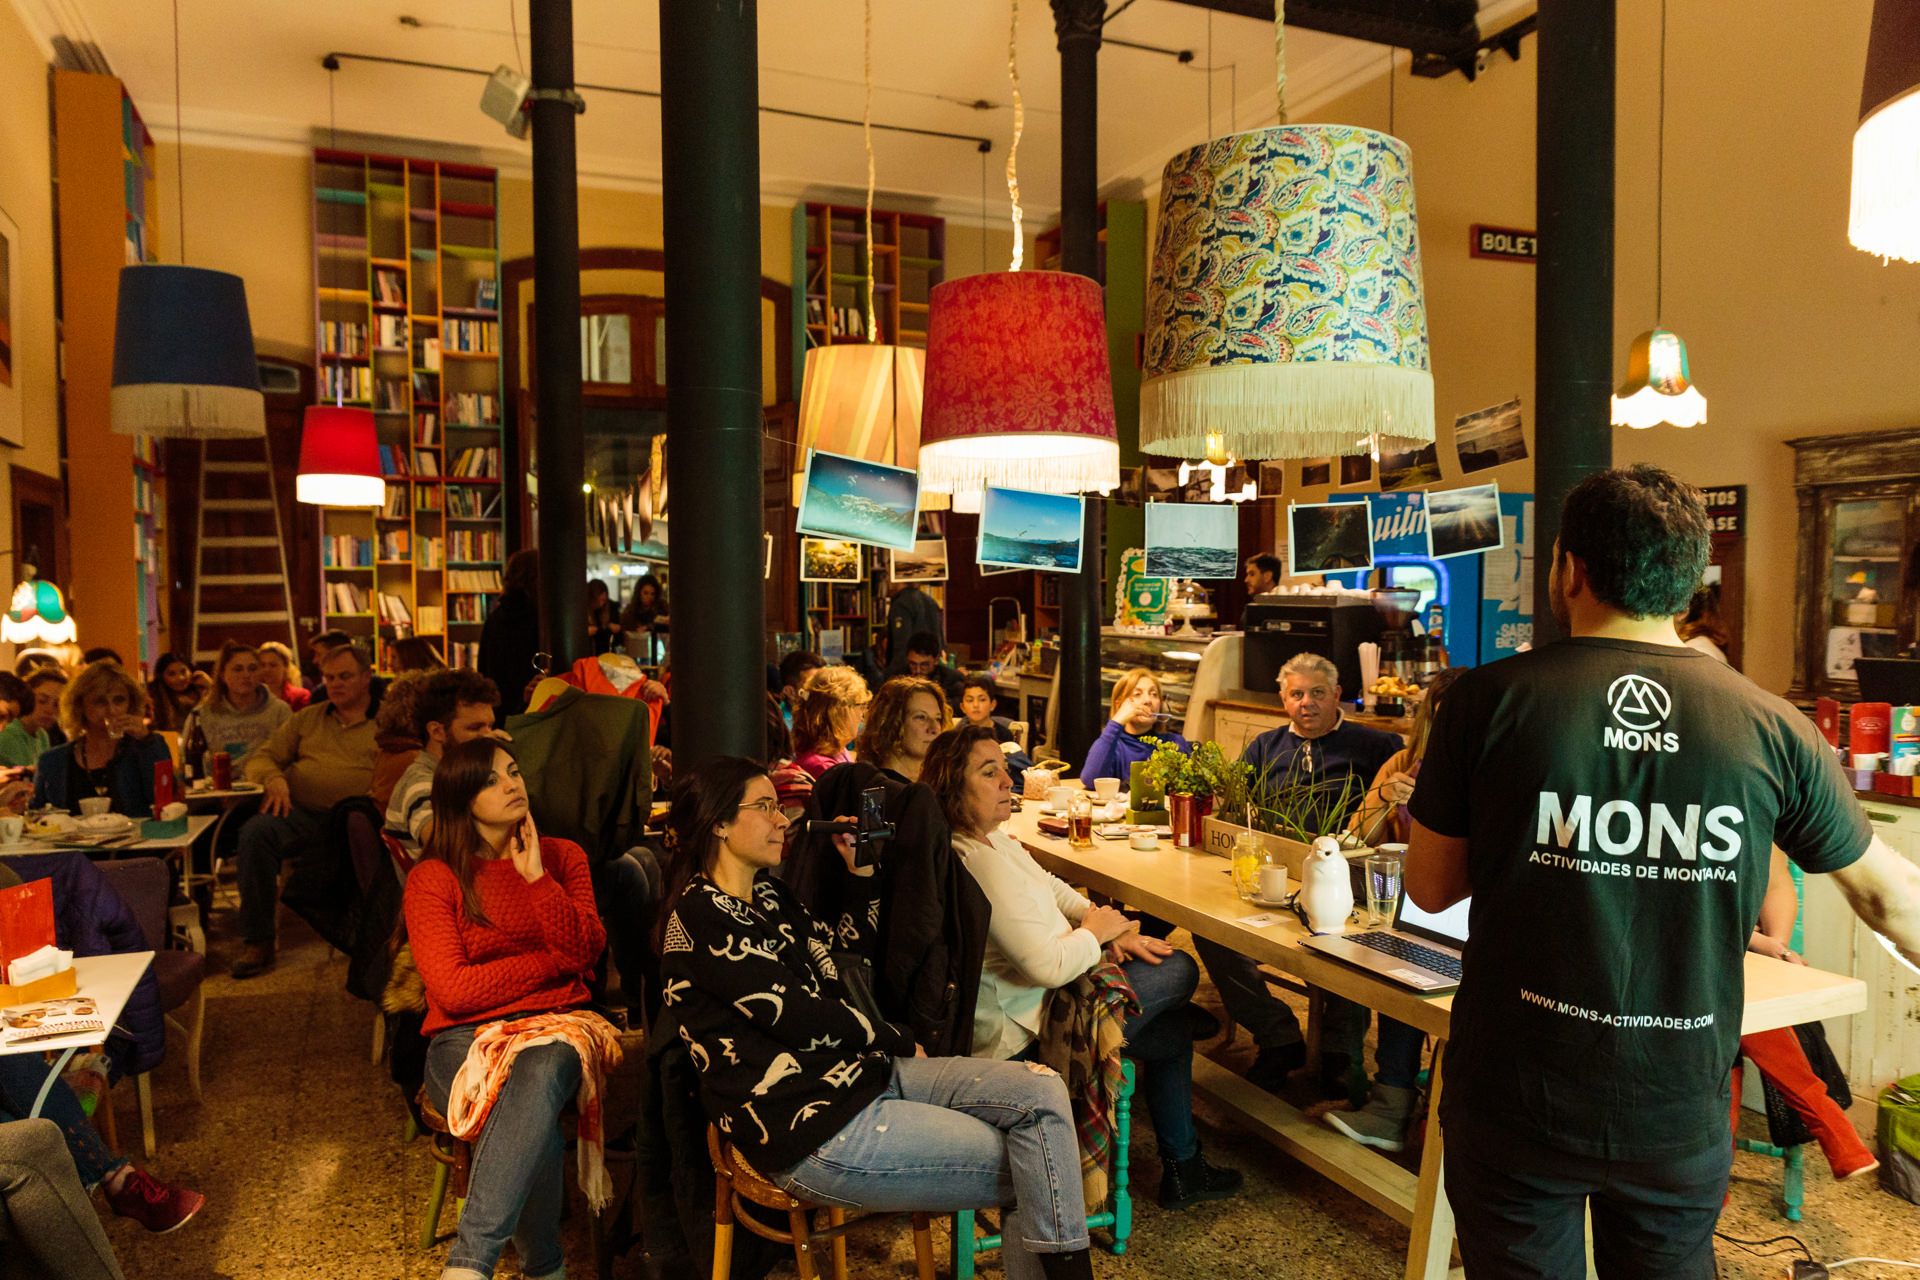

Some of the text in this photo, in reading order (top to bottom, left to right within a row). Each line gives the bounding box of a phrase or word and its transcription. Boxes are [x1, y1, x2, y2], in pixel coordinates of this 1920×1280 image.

[1603, 726, 1680, 753] MONS
[1536, 791, 1745, 862] MONS
[1529, 850, 1631, 877] ACTIVIDADES
[1635, 865, 1659, 880] DE
[1520, 988, 1715, 1030] WWW.MONS-ACTIVIDADES.COM
